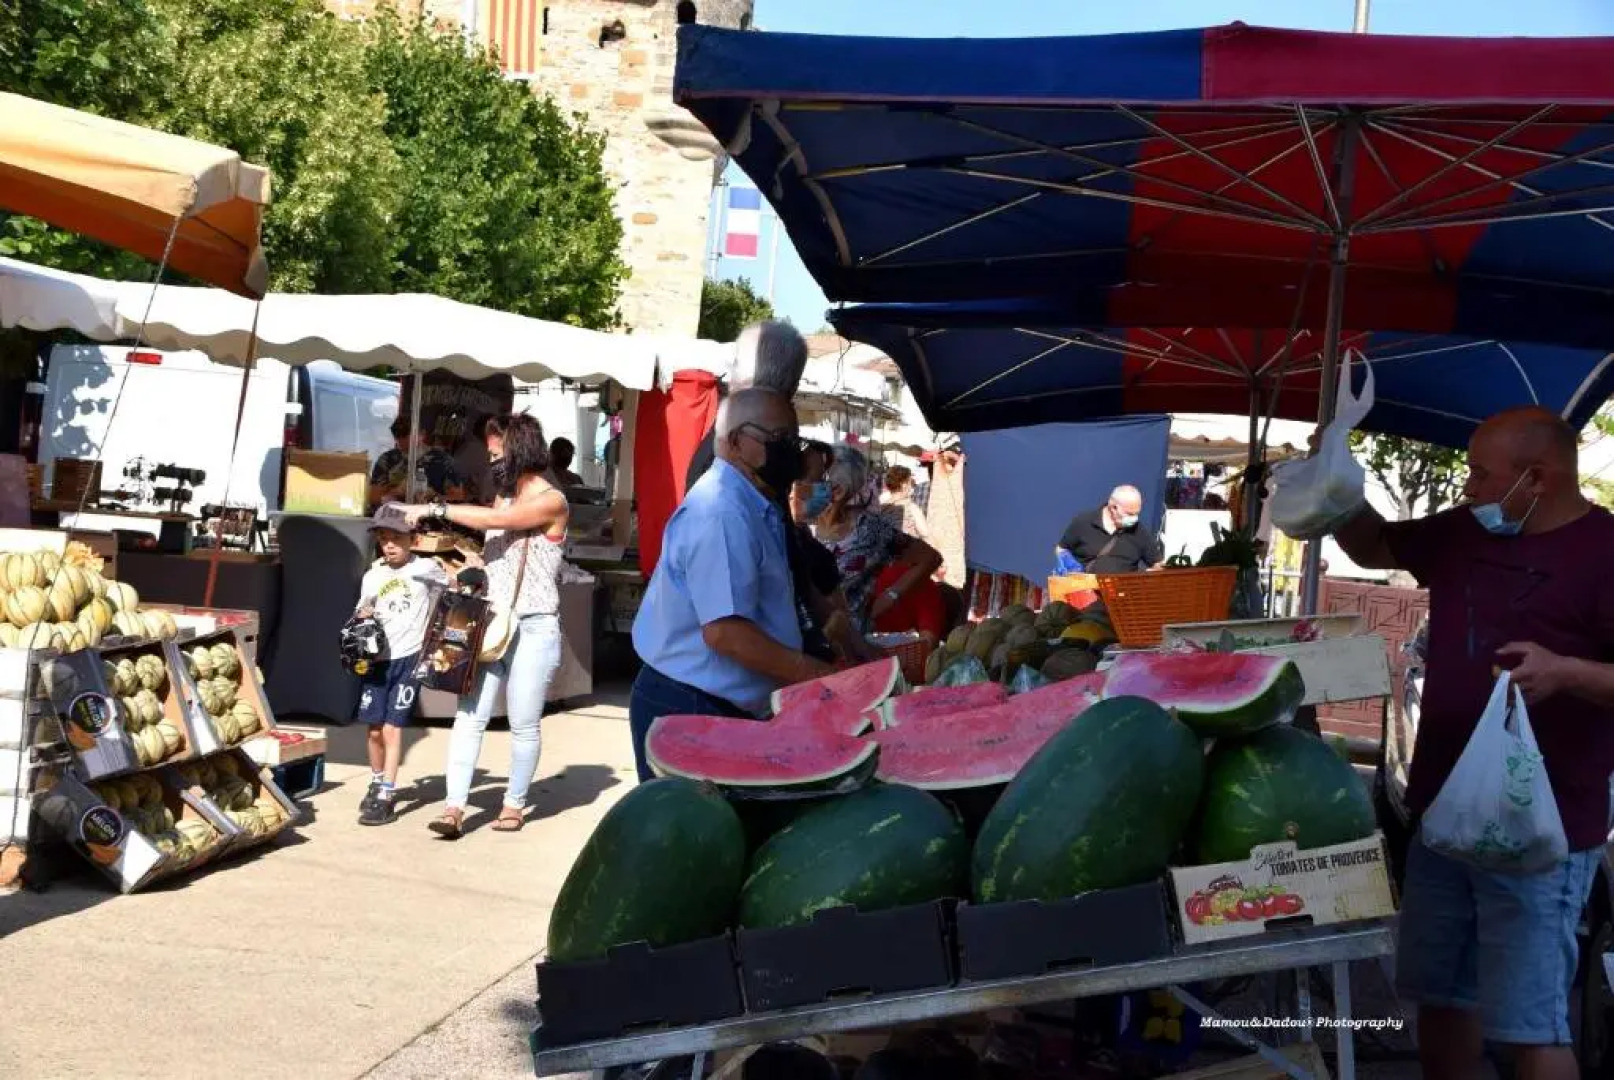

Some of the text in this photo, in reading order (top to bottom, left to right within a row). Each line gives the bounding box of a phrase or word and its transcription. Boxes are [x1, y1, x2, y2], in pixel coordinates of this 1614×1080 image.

[397, 684, 415, 704] 10
[1270, 858, 1316, 876] TOMATES
[1330, 848, 1379, 867] PROVENCE
